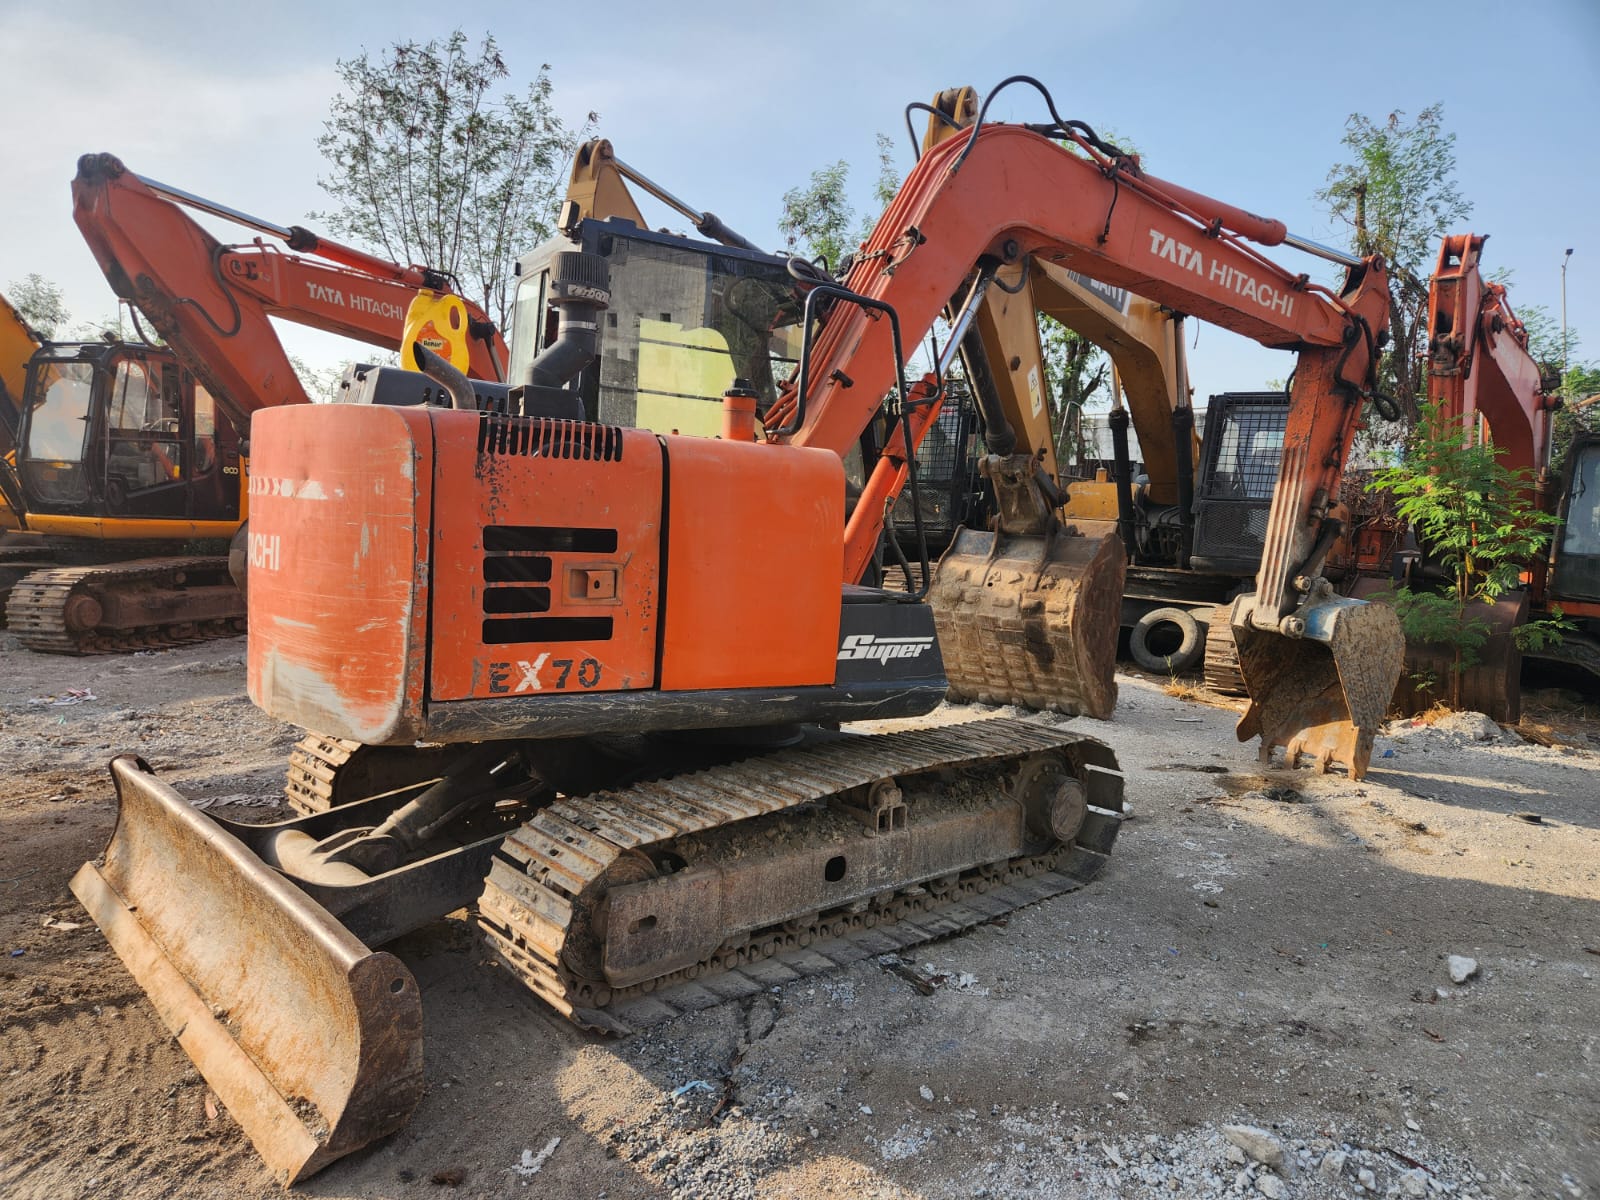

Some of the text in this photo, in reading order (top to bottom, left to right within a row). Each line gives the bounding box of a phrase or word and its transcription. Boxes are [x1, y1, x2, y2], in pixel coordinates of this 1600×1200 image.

[1149, 228, 1295, 318] TATA HITACHI
[306, 281, 404, 321] TATA HITACHI
[837, 634, 935, 667] Super
[489, 652, 602, 694] EX70
